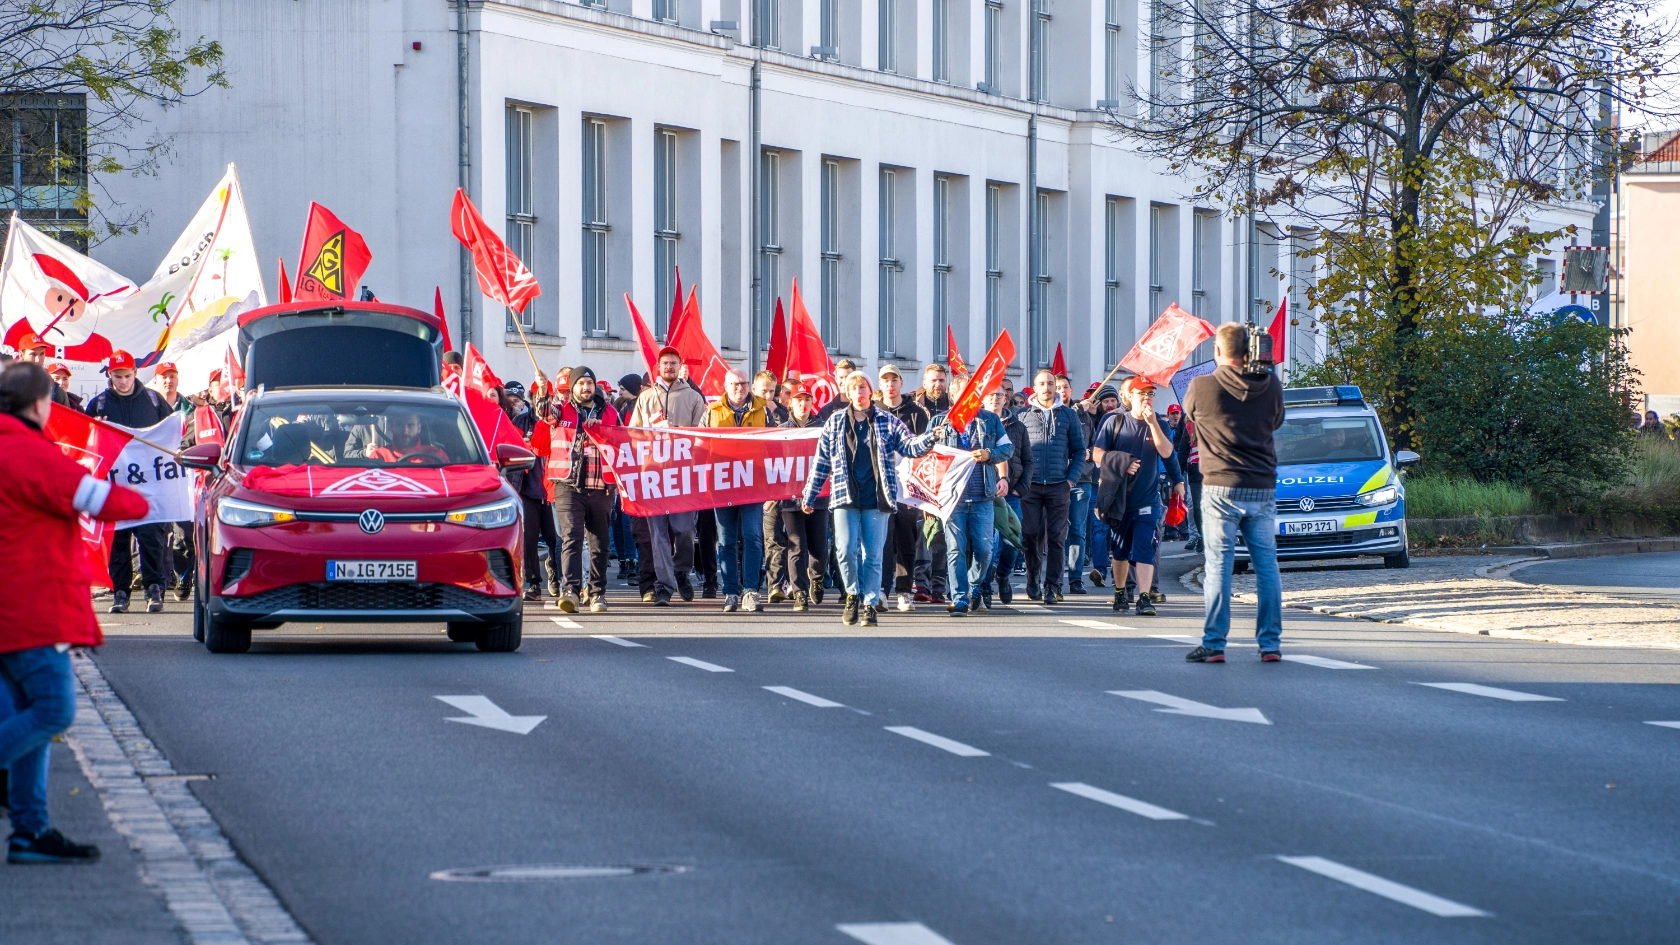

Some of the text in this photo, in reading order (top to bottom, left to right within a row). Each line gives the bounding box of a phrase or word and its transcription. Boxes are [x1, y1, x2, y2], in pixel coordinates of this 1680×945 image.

[1592, 299, 1600, 310] B
[599, 434, 692, 468] DAFÜR
[127, 463, 147, 484] &
[617, 459, 754, 501] TREITEN
[1289, 522, 1332, 532] N PP 171
[337, 563, 346, 577] N
[357, 563, 375, 577] IG
[378, 563, 415, 577] 715E
